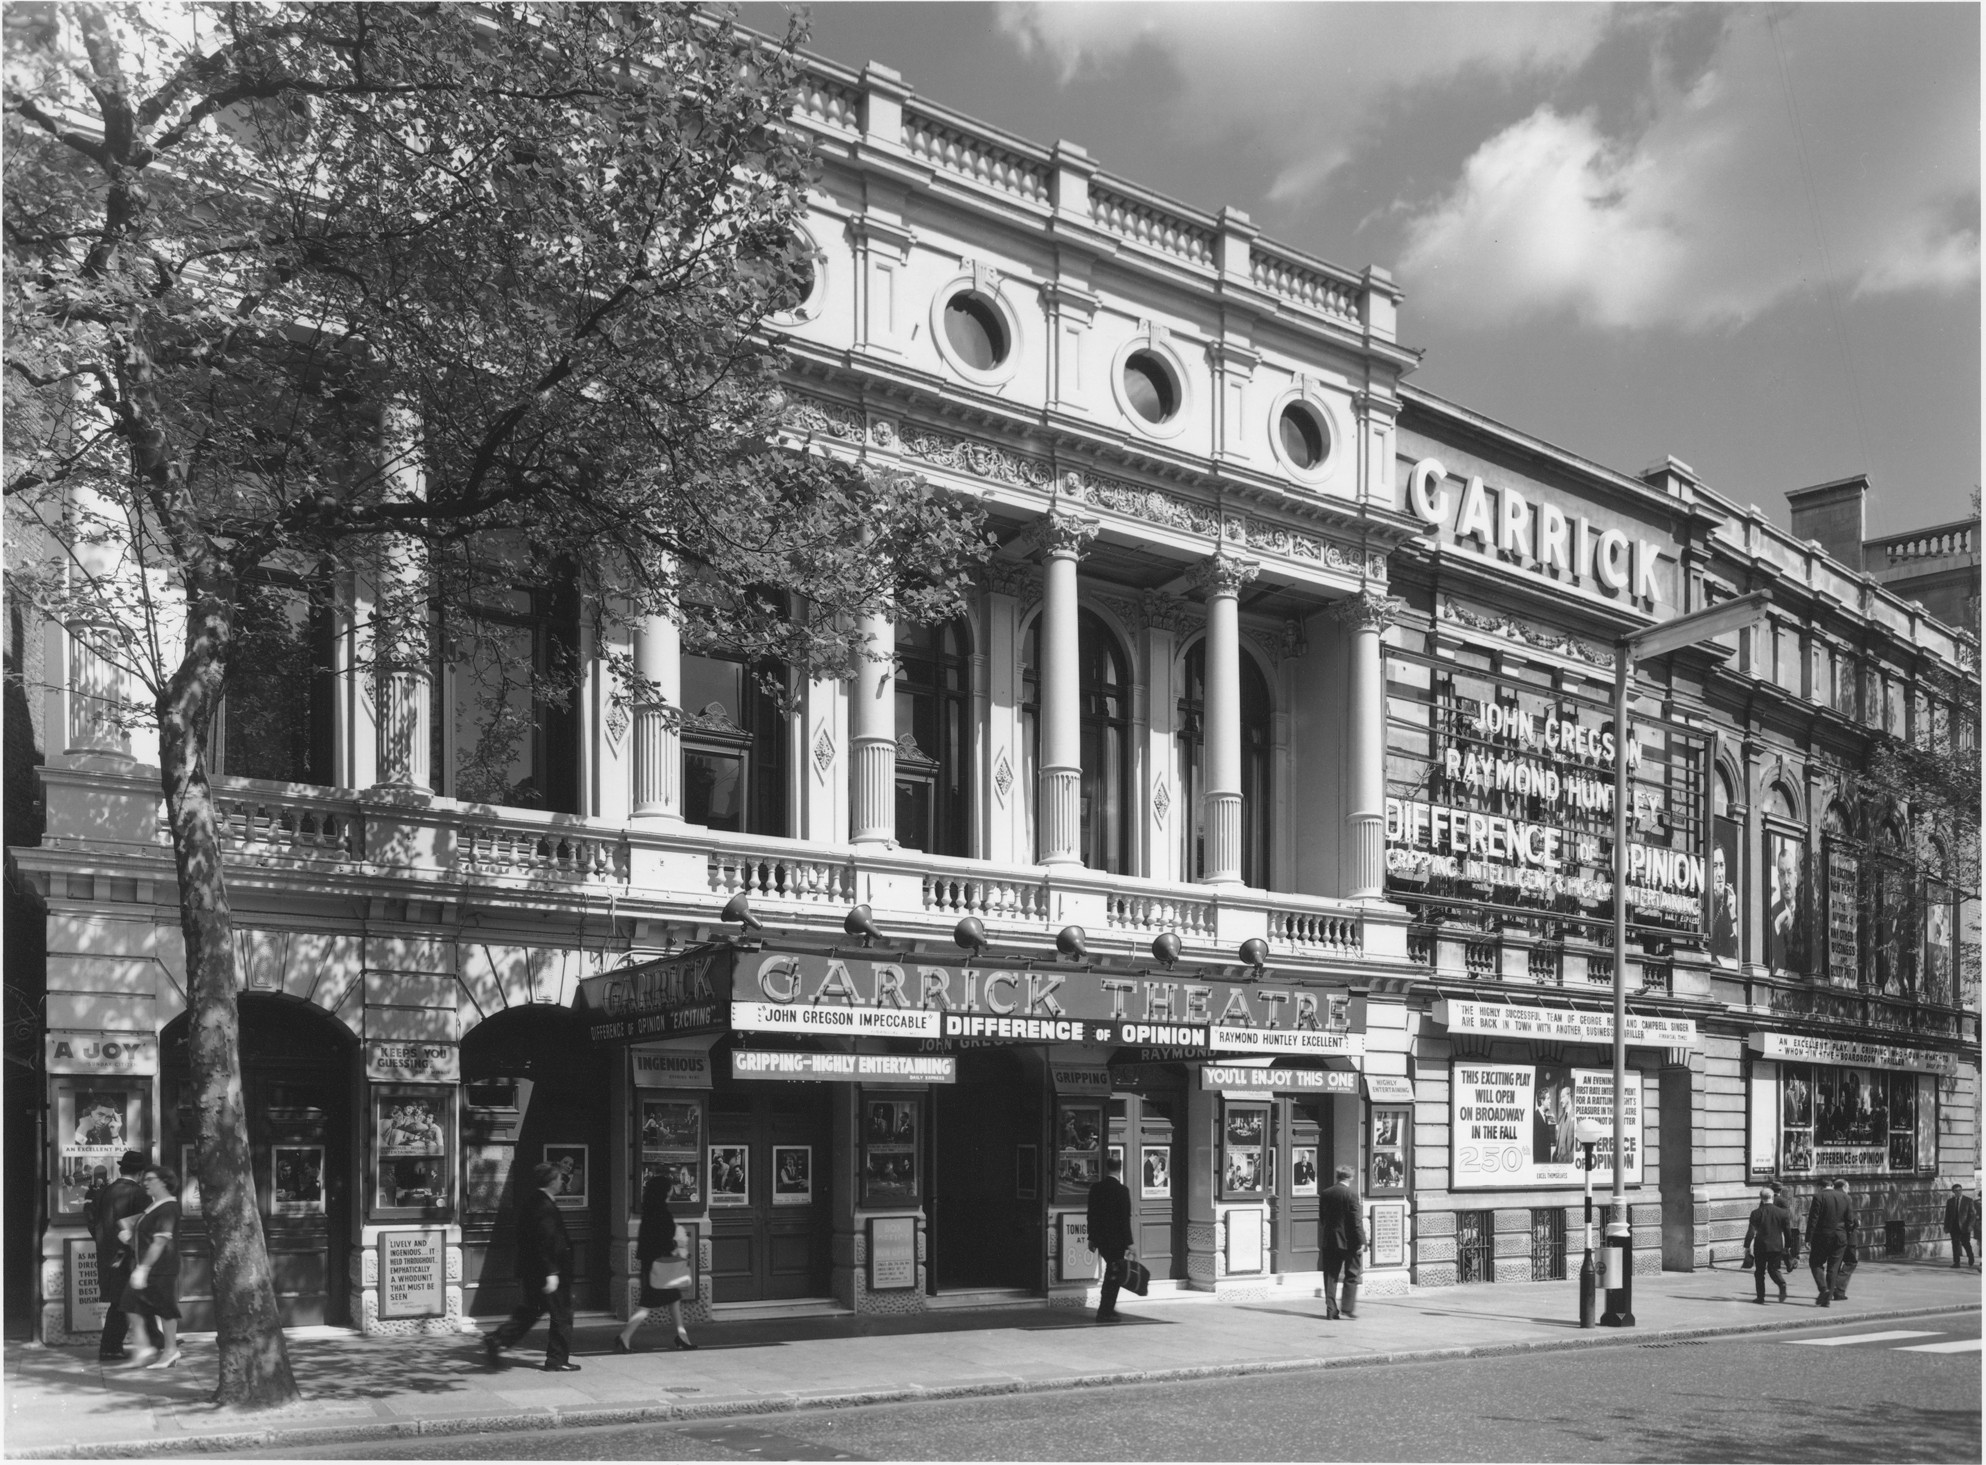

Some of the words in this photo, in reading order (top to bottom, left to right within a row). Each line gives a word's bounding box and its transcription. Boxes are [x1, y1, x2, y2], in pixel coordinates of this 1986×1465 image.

[1410, 458, 1662, 601] GARRICK
[1472, 700, 1535, 745] JOHN
[1446, 748, 1559, 801] RAYMOND
[1568, 776, 1660, 822] HUNTEY
[1386, 797, 1561, 868] DIFFERENCE
[1579, 843, 1595, 862] OF
[1555, 874, 1566, 894] &
[1568, 876, 1612, 901] HIGHLY
[1625, 886, 1699, 915] NTERTAINING
[602, 955, 716, 1017] GARRICK
[758, 955, 1066, 1017] GARRICK
[1101, 979, 1351, 1030] THEATRE
[803, 1012, 853, 1026] GREGSON
[1461, 1016, 1474, 1027] ARE
[1480, 1018, 1497, 1029] BACK
[1503, 1019, 1510, 1030] IN
[1515, 1020, 1532, 1032] TOWN
[1536, 1022, 1552, 1033] WITH
[1556, 1024, 1581, 1036] ANOTHER
[1586, 1026, 1614, 1037] BUSINESS
[1480, 1006, 1501, 1018] HIGHLY
[1505, 1008, 1541, 1021] SUCCESSFUL
[1546, 1012, 1562, 1023] TEAM
[1568, 1014, 1575, 1024] OF
[1580, 1015, 1602, 1025] GEORGE
[1626, 1019, 1637, 1028] AND
[1641, 1020, 1667, 1031] CAMPBELL
[1671, 1022, 1689, 1032] SINGER
[590, 1022, 624, 1040] DIFFERENCE
[628, 1023, 634, 1035] OF
[638, 1015, 665, 1033] OPINION
[946, 1015, 1084, 1041] DIFFERENCE
[1095, 1028, 1111, 1041] OF
[1122, 1025, 1205, 1046] OPINION
[918, 1038, 952, 1052] JOHN
[1262, 1034, 1298, 1046] HUNTLEY
[1794, 1038, 1828, 1050] EXCELLENT
[1852, 1045, 1857, 1054] A
[1861, 1046, 1887, 1056] GRIPPING
[424, 1049, 447, 1059] YOU
[1252, 1071, 1294, 1086] ENJOY
[1297, 1071, 1323, 1087] THIS
[1461, 1070, 1479, 1084] THIS
[1481, 1071, 1514, 1086] EXCITING
[1515, 1072, 1531, 1087] PLAY
[1583, 1076, 1591, 1084] AN
[1475, 1089, 1494, 1103] WILL
[1495, 1090, 1515, 1104] OPEN
[1576, 1086, 1588, 1095] FIRST
[1589, 1086, 1600, 1095] RATE
[1576, 1096, 1585, 1105] FOR
[1587, 1096, 1591, 1105] A
[1592, 1096, 1613, 1106] RATTLIN
[1460, 1106, 1473, 1121] ON
[1476, 1107, 1525, 1122] BROADWAY
[1576, 1106, 1600, 1115] PLEASURE
[1601, 1106, 1606, 1115] IN
[1471, 1125, 1481, 1140] IN
[1483, 1125, 1498, 1140] THE
[1500, 1125, 1518, 1140] FALL
[1816, 1151, 1851, 1165] DIFFERENCE
[1852, 1154, 1858, 1164] OF
[1859, 1151, 1884, 1165] OPINION
[1066, 1224, 1088, 1235] TONIG
[414, 1239, 427, 1247] AND
[78, 1261, 98, 1269] DIREC
[390, 1266, 431, 1274] EMPHATICALLY
[78, 1270, 98, 1278] THIS
[398, 1274, 432, 1282] WHODUNIT
[390, 1284, 405, 1292] THAT
[407, 1283, 425, 1291] MUST
[427, 1282, 435, 1290] BE
